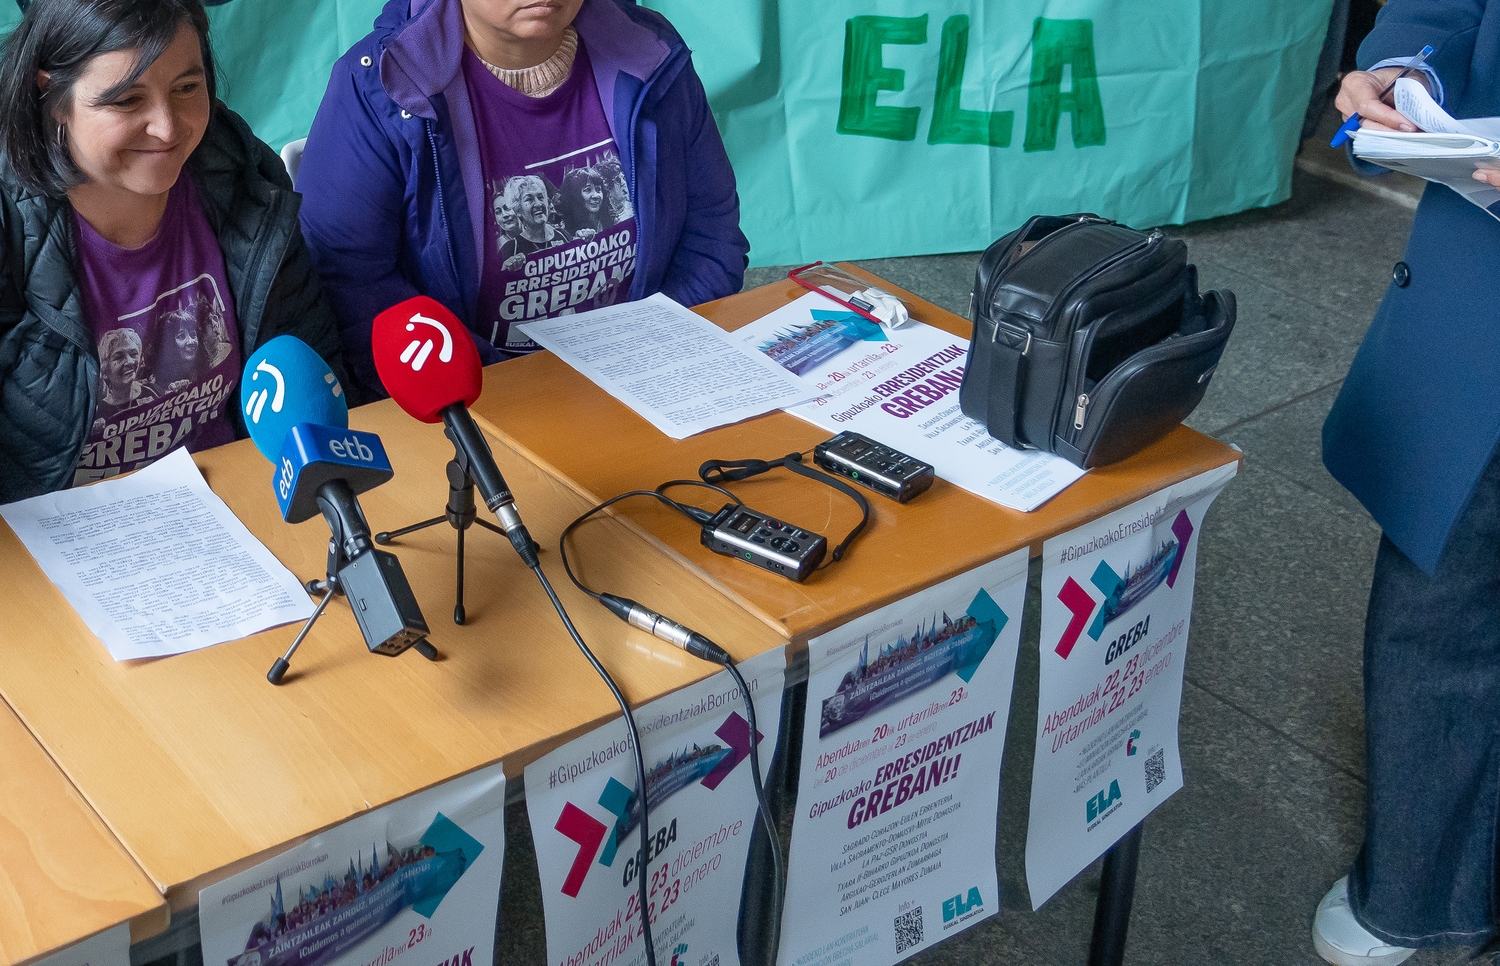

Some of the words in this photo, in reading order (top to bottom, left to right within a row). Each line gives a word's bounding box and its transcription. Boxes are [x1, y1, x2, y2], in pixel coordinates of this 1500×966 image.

[836, 13, 1107, 152] ELA
[504, 242, 637, 296] ERRESIDENTZIA
[524, 229, 631, 277] GIPUZKOAKO
[830, 393, 884, 423] Gipuzkoako
[871, 343, 969, 398] ERRESIDENTZIAK
[862, 370, 877, 380] 23
[328, 435, 374, 462] etb
[279, 456, 295, 500] etb
[1104, 613, 1151, 666] GREBA
[1041, 682, 1103, 739] Abenduak
[1101, 668, 1120, 698] 22,
[1122, 653, 1140, 682] 23
[1139, 619, 1185, 668] diciembre
[1051, 700, 1108, 754] Urtarrilak
[1107, 685, 1126, 715] 22,
[1127, 670, 1145, 699] 23
[1144, 652, 1172, 685] enero
[815, 737, 871, 771] Abenduaren
[897, 697, 950, 731] urtarrilaren
[948, 686, 969, 707] 23ra
[809, 779, 872, 820] Gipuzkoako
[873, 710, 997, 788] ERRESIDENTZIAK
[823, 766, 837, 784] 20
[894, 733, 907, 750] 23
[847, 752, 963, 830] GREBAN!!
[1086, 778, 1122, 824] ELA
[829, 859, 847, 873] VILLA
[932, 802, 962, 823] DONOSTIA
[841, 834, 870, 855] SAGRADO
[870, 809, 919, 841] CORAZON-EULEN
[919, 793, 953, 817] ERRENTERIA
[861, 859, 871, 869] LA
[871, 845, 898, 865] PAZ-GSR
[898, 831, 928, 853] DONOSTIA
[649, 862, 669, 899] 23
[671, 819, 743, 877] diciembre
[889, 847, 920, 869] GIPUZKOA
[920, 832, 949, 854] DONOSTIA
[906, 848, 942, 874] ZUMARRAGA
[660, 878, 681, 914] 23
[683, 853, 722, 893] enero
[839, 906, 852, 917] SAN
[871, 886, 891, 902] CLECE
[891, 872, 919, 893] MAYORES
[919, 861, 942, 880] ZUMAIA
[941, 886, 984, 924] ELA
[267, 918, 332, 959] ZAINTZAILEAK
[298, 933, 340, 960] ¡Cuidemos
[407, 923, 433, 950] 23ra
[943, 920, 959, 931] EUSKAL
